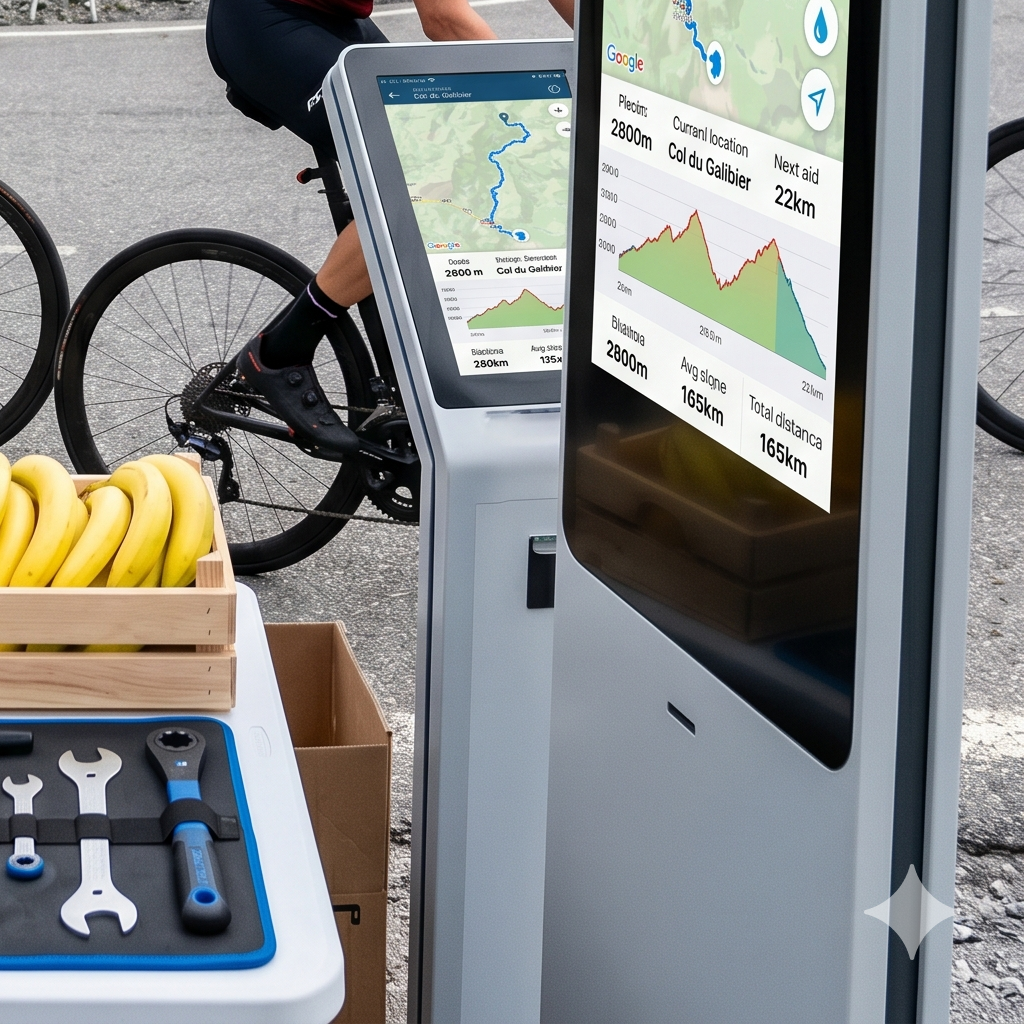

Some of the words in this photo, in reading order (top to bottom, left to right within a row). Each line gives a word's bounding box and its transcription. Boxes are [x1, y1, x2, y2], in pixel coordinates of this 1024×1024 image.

[607, 44, 644, 73] Google
[610, 117, 653, 151] 2800m
[709, 128, 749, 158] location
[668, 142, 687, 165] Col
[688, 150, 703, 171] du
[706, 157, 752, 191] Galibier
[774, 153, 800, 178] Next
[801, 168, 820, 186] aid
[774, 184, 816, 219] 22km
[473, 268, 484, 277] m
[496, 266, 513, 275] Col
[514, 266, 527, 274] du
[473, 359, 509, 368] 280km
[606, 339, 648, 380] 2800m
[680, 355, 699, 382] Avg
[681, 384, 724, 427] 165km
[748, 393, 774, 423] Total
[759, 432, 808, 479] 165km
